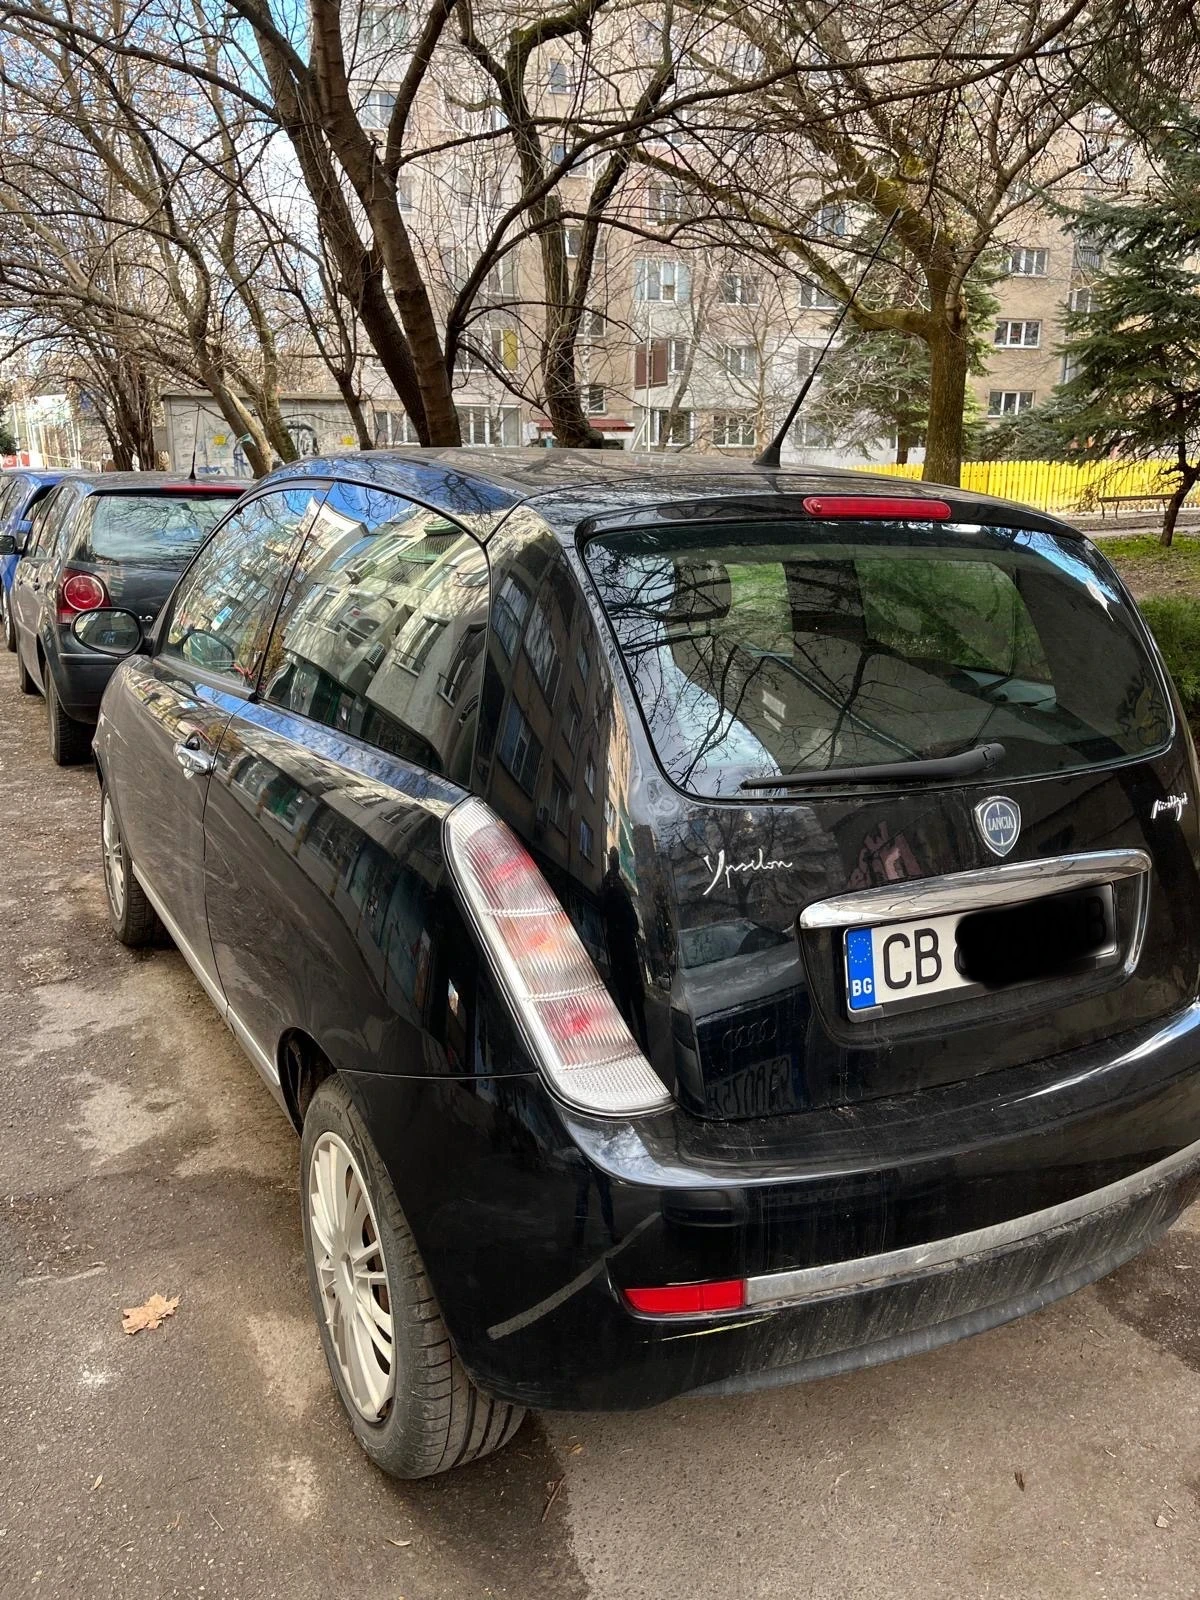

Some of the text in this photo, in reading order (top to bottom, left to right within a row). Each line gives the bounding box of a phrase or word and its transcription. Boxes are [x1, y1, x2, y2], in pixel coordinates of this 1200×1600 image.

[987, 815, 1015, 832] LANCIA
[702, 848, 793, 896] Ypsilon
[883, 927, 943, 990] CB
[852, 977, 873, 997] BG
